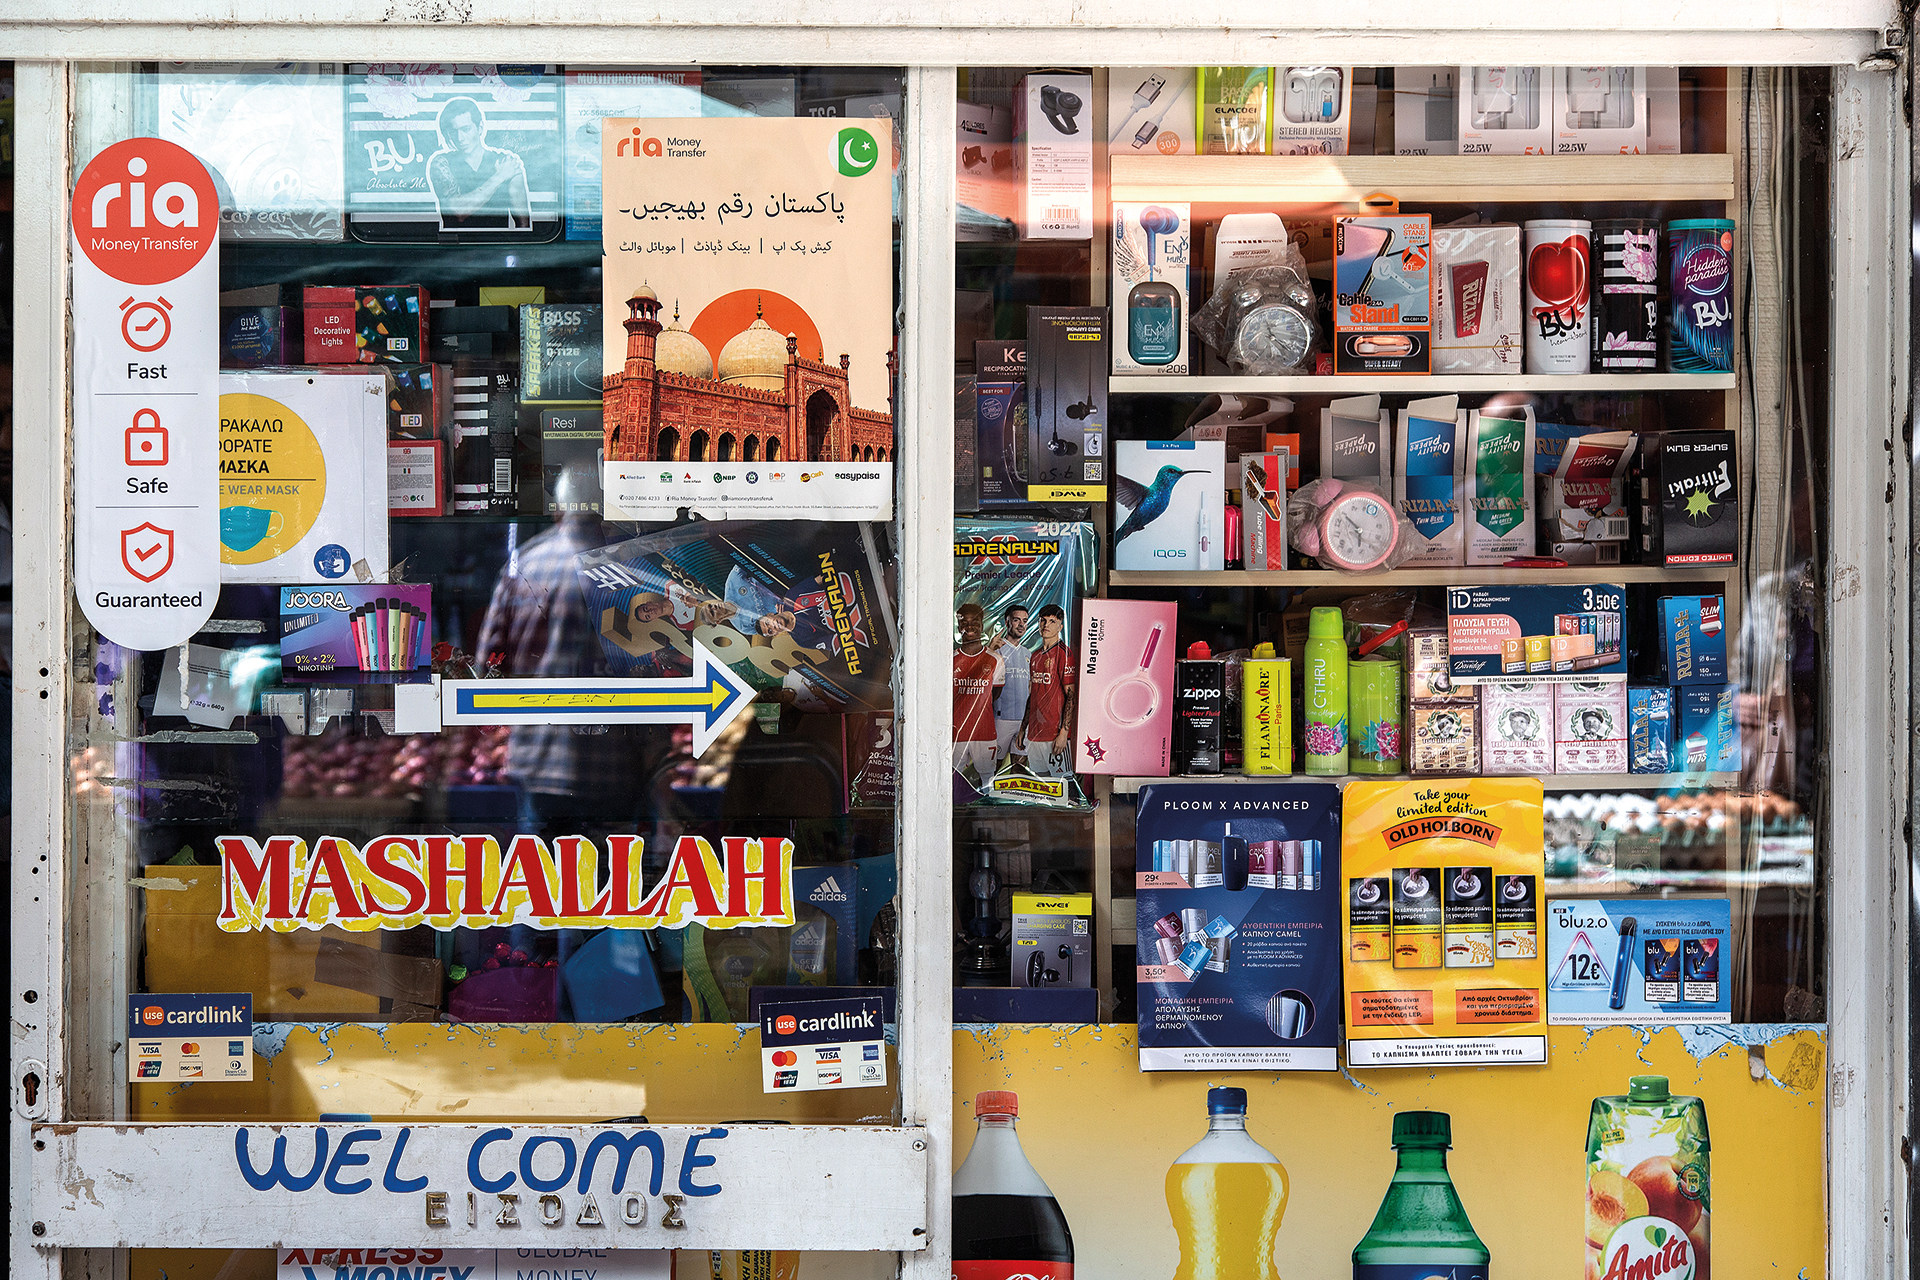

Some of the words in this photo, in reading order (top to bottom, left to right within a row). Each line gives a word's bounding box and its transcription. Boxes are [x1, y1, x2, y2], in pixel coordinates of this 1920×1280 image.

[1279, 127, 1308, 136] STEREO
[1310, 127, 1343, 136] HEADSET
[617, 127, 662, 157] ria
[667, 137, 701, 147] Money
[1159, 138, 1178, 150] 300
[1463, 144, 1492, 153] 22.5W
[1558, 143, 1587, 152] 22.5W
[667, 148, 706, 158] Transfer
[367, 178, 407, 190] Absolute
[410, 177, 427, 188] Me
[91, 156, 199, 228] ria
[717, 193, 752, 225] رقم
[765, 191, 845, 223] پاکستان
[91, 237, 140, 253] Money
[141, 237, 199, 250] Transfer
[1685, 256, 1728, 275] Hidden
[1684, 265, 1730, 289] paradise
[324, 315, 340, 324] LED
[543, 311, 582, 326] BASS
[1350, 303, 1399, 324] Stand
[1692, 297, 1732, 329] B.U.
[1537, 306, 1581, 340] B.U.
[313, 327, 351, 335] Decorative
[321, 337, 343, 347] Lights
[389, 340, 407, 349] LED
[525, 307, 541, 398] SPEAKERS
[127, 362, 168, 379] Fast
[402, 416, 421, 425] LED
[1343, 440, 1376, 456] QUALITY
[1409, 434, 1441, 452] PAPERS
[1417, 442, 1450, 457] QUALITY
[1480, 433, 1511, 451] PAPERS
[1487, 440, 1521, 455] QUALITY
[1694, 443, 1729, 451] SUPER
[834, 471, 880, 481] easypaisa
[1668, 460, 1732, 498] Filtraki
[126, 478, 169, 494] Safe
[229, 485, 263, 495] WEAR
[265, 485, 300, 495] MASK
[1416, 517, 1430, 525] THIN
[1430, 515, 1445, 524] BLUE
[1037, 522, 1081, 537] 2024
[1153, 549, 1187, 558] IQOS
[964, 570, 1001, 580] Premier
[1004, 569, 1041, 580] League
[95, 592, 202, 608] Guaranteed
[286, 592, 353, 611] JOORA
[1452, 591, 1471, 609] iD
[818, 552, 862, 675] ADRENALYN
[1700, 605, 1720, 617] SLIM
[284, 613, 319, 633] UNLIMITED
[1453, 619, 1485, 627] ΠΛΟΥΣΙΑ
[1487, 619, 1510, 627] ΓΕΥΣΗ
[1086, 616, 1099, 675] Magnifier
[1454, 660, 1487, 670] Davidoff
[953, 678, 990, 687] Emirates
[1183, 687, 1221, 701] zippo
[1650, 692, 1668, 701] ULTRA
[1651, 700, 1667, 708] SLIM
[1182, 710, 1204, 718] Lighter
[1274, 704, 1283, 725] Paris
[875, 718, 893, 748] 3
[1089, 741, 1101, 760] NEW
[1049, 753, 1063, 768] 49
[1686, 753, 1707, 764] SLIM
[999, 782, 1059, 794] PANINI
[1414, 789, 1440, 801] Take
[1443, 791, 1470, 803] your
[1164, 801, 1213, 810] PLOOM
[1219, 801, 1227, 810] X
[1233, 801, 1310, 810] ADVANCED
[1396, 802, 1442, 818] limited
[1446, 802, 1488, 817] edition
[1390, 825, 1419, 843] OLD
[1422, 820, 1495, 841] HOLBORN
[218, 836, 791, 926] MASHALLAH
[809, 891, 847, 901] adidas
[1648, 947, 1660, 955] blu
[1145, 968, 1166, 976] 3,50€
[1568, 954, 1600, 980] 12€
[135, 1007, 139, 1024] i
[145, 1012, 162, 1020] use
[167, 1006, 243, 1024] cardlink
[767, 1017, 772, 1034] i
[777, 1021, 795, 1029] use
[799, 1010, 874, 1032] cardlink
[235, 1126, 429, 1195] WEL
[467, 1127, 729, 1198] COME
[425, 1191, 686, 1228] ΕΙΣΟΔΟΣ
[1602, 1235, 1689, 1280] Amita
